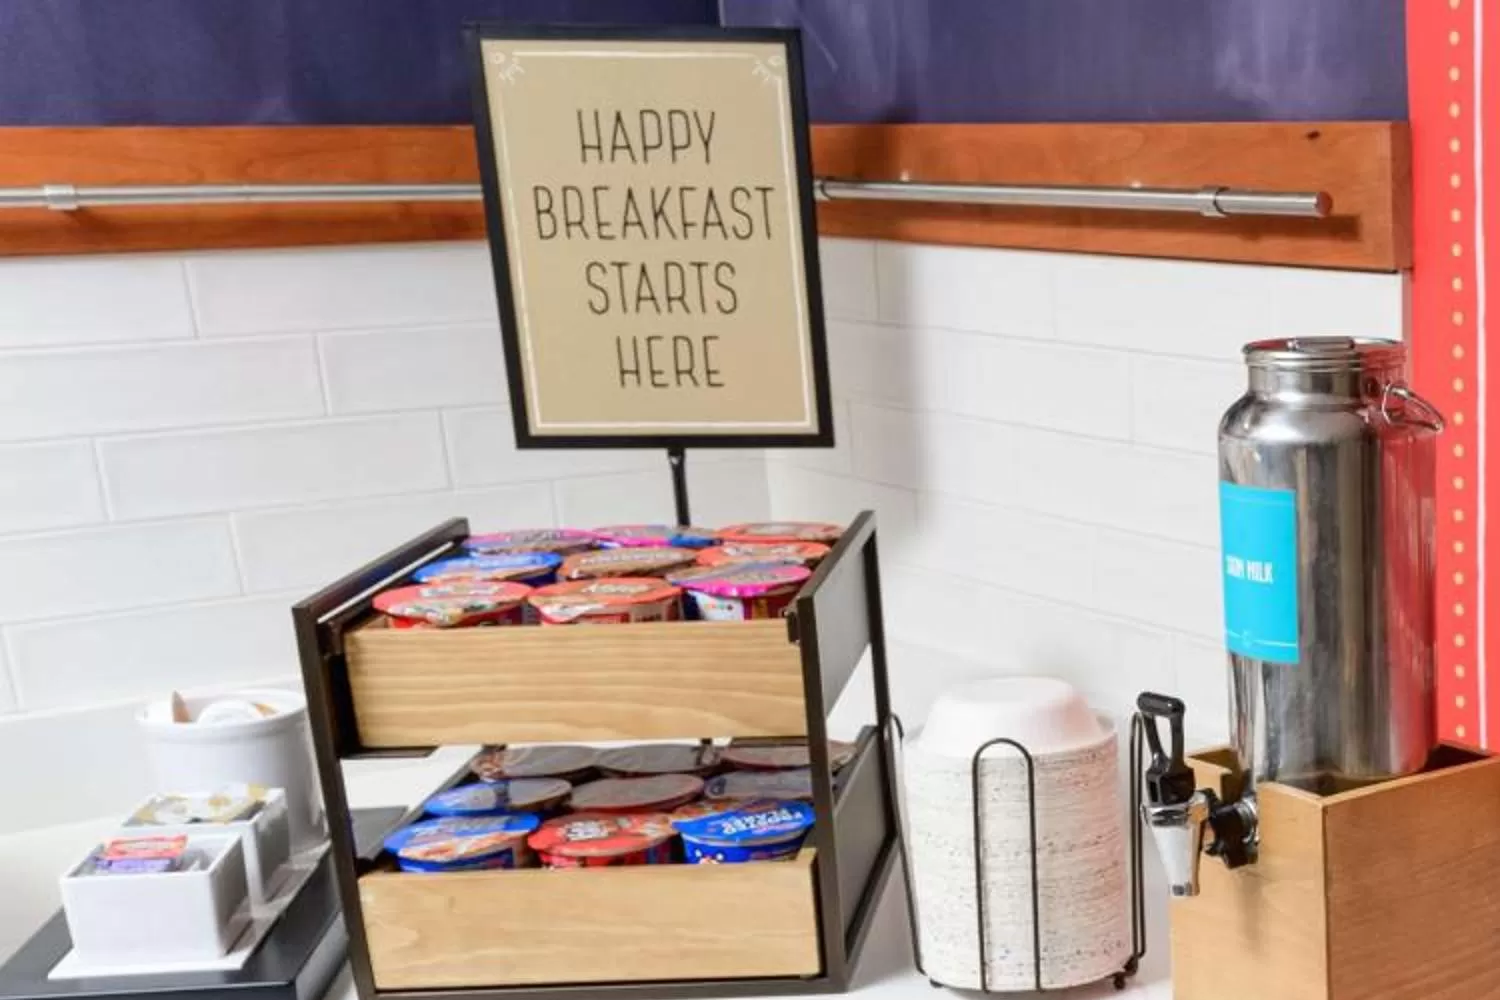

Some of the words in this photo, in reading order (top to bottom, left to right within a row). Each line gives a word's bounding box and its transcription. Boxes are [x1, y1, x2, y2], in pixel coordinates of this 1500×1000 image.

[577, 109, 716, 165] HAPPY
[532, 185, 775, 241] BREAKFAST
[585, 260, 740, 316] STARTS
[616, 334, 726, 388] HERE
